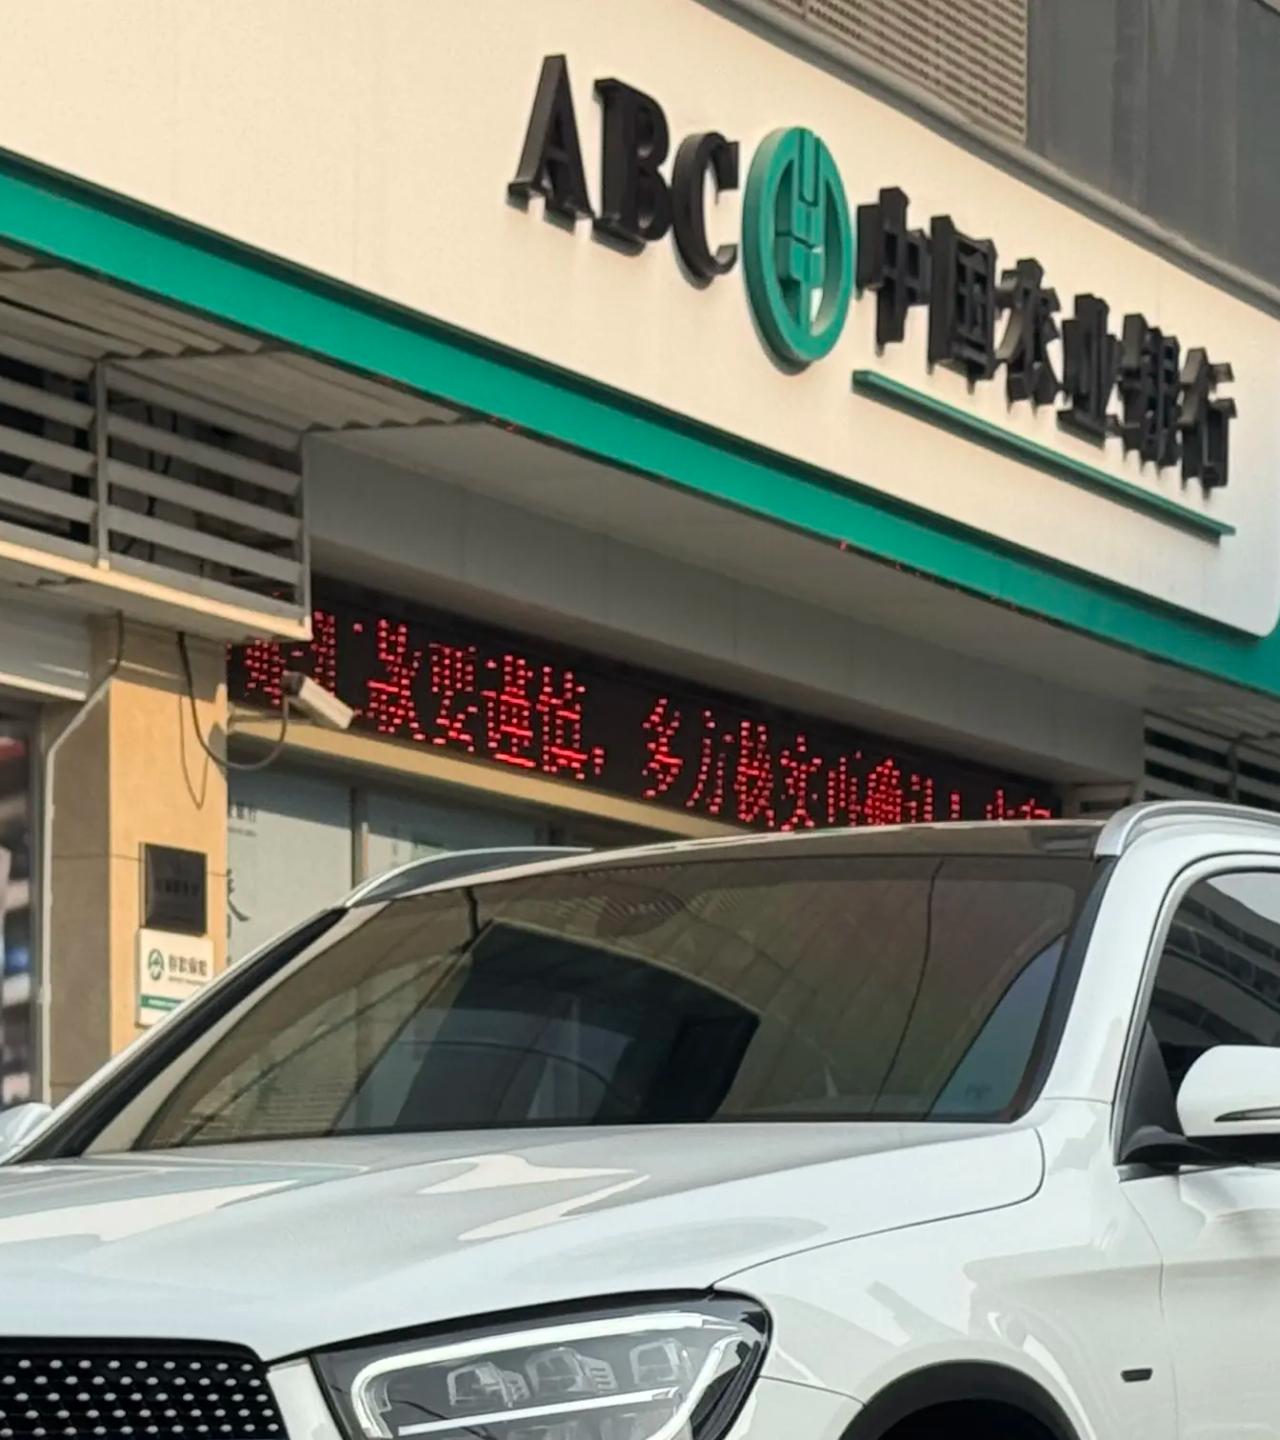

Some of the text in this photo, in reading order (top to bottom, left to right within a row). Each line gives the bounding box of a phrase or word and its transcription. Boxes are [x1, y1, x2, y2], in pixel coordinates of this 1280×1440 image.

[507, 54, 740, 286] ABC
[856, 186, 1237, 490] 中国农业银行
